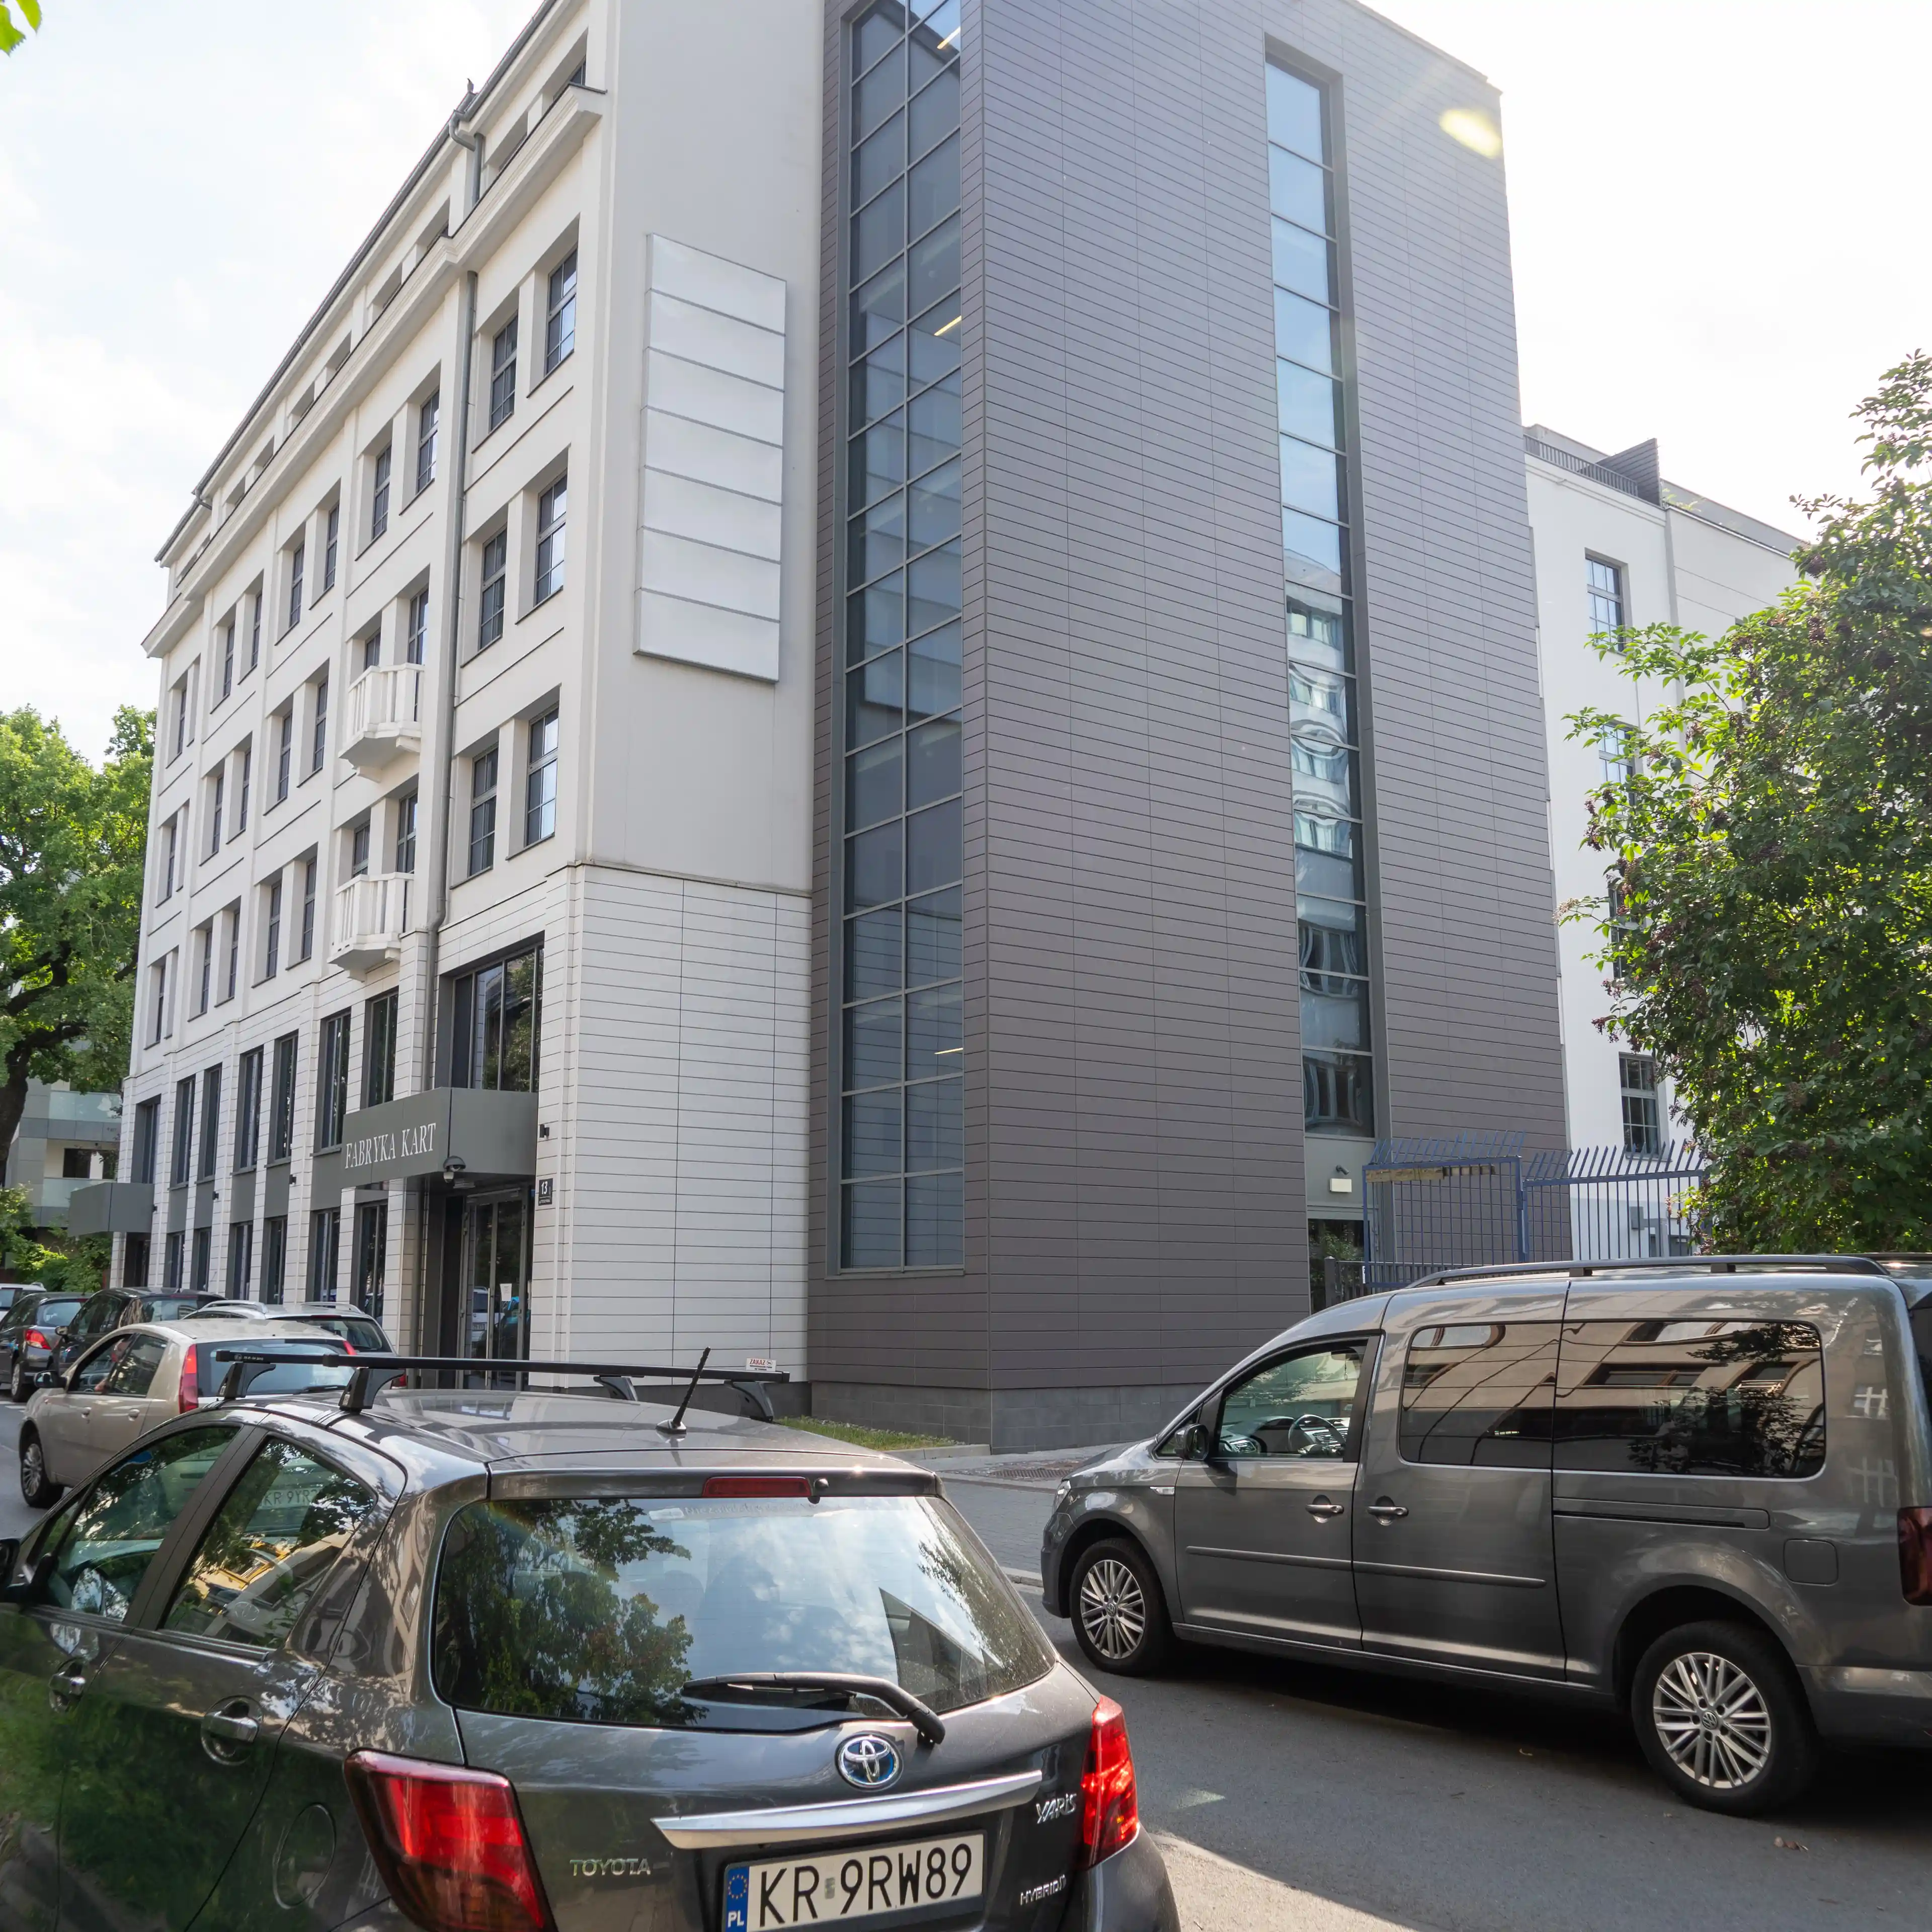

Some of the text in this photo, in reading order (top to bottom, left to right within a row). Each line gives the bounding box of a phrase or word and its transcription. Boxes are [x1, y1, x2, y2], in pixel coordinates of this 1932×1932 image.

[345, 1122, 436, 1169] FABRYKA KART
[541, 1181, 548, 1195] 13
[264, 1491, 283, 1507] KR
[570, 1858, 651, 1877] TOYOTA
[759, 1843, 973, 1927] KR 9RW89
[1019, 1879, 1059, 1906] HYBRID
[727, 1910, 745, 1928] PL
